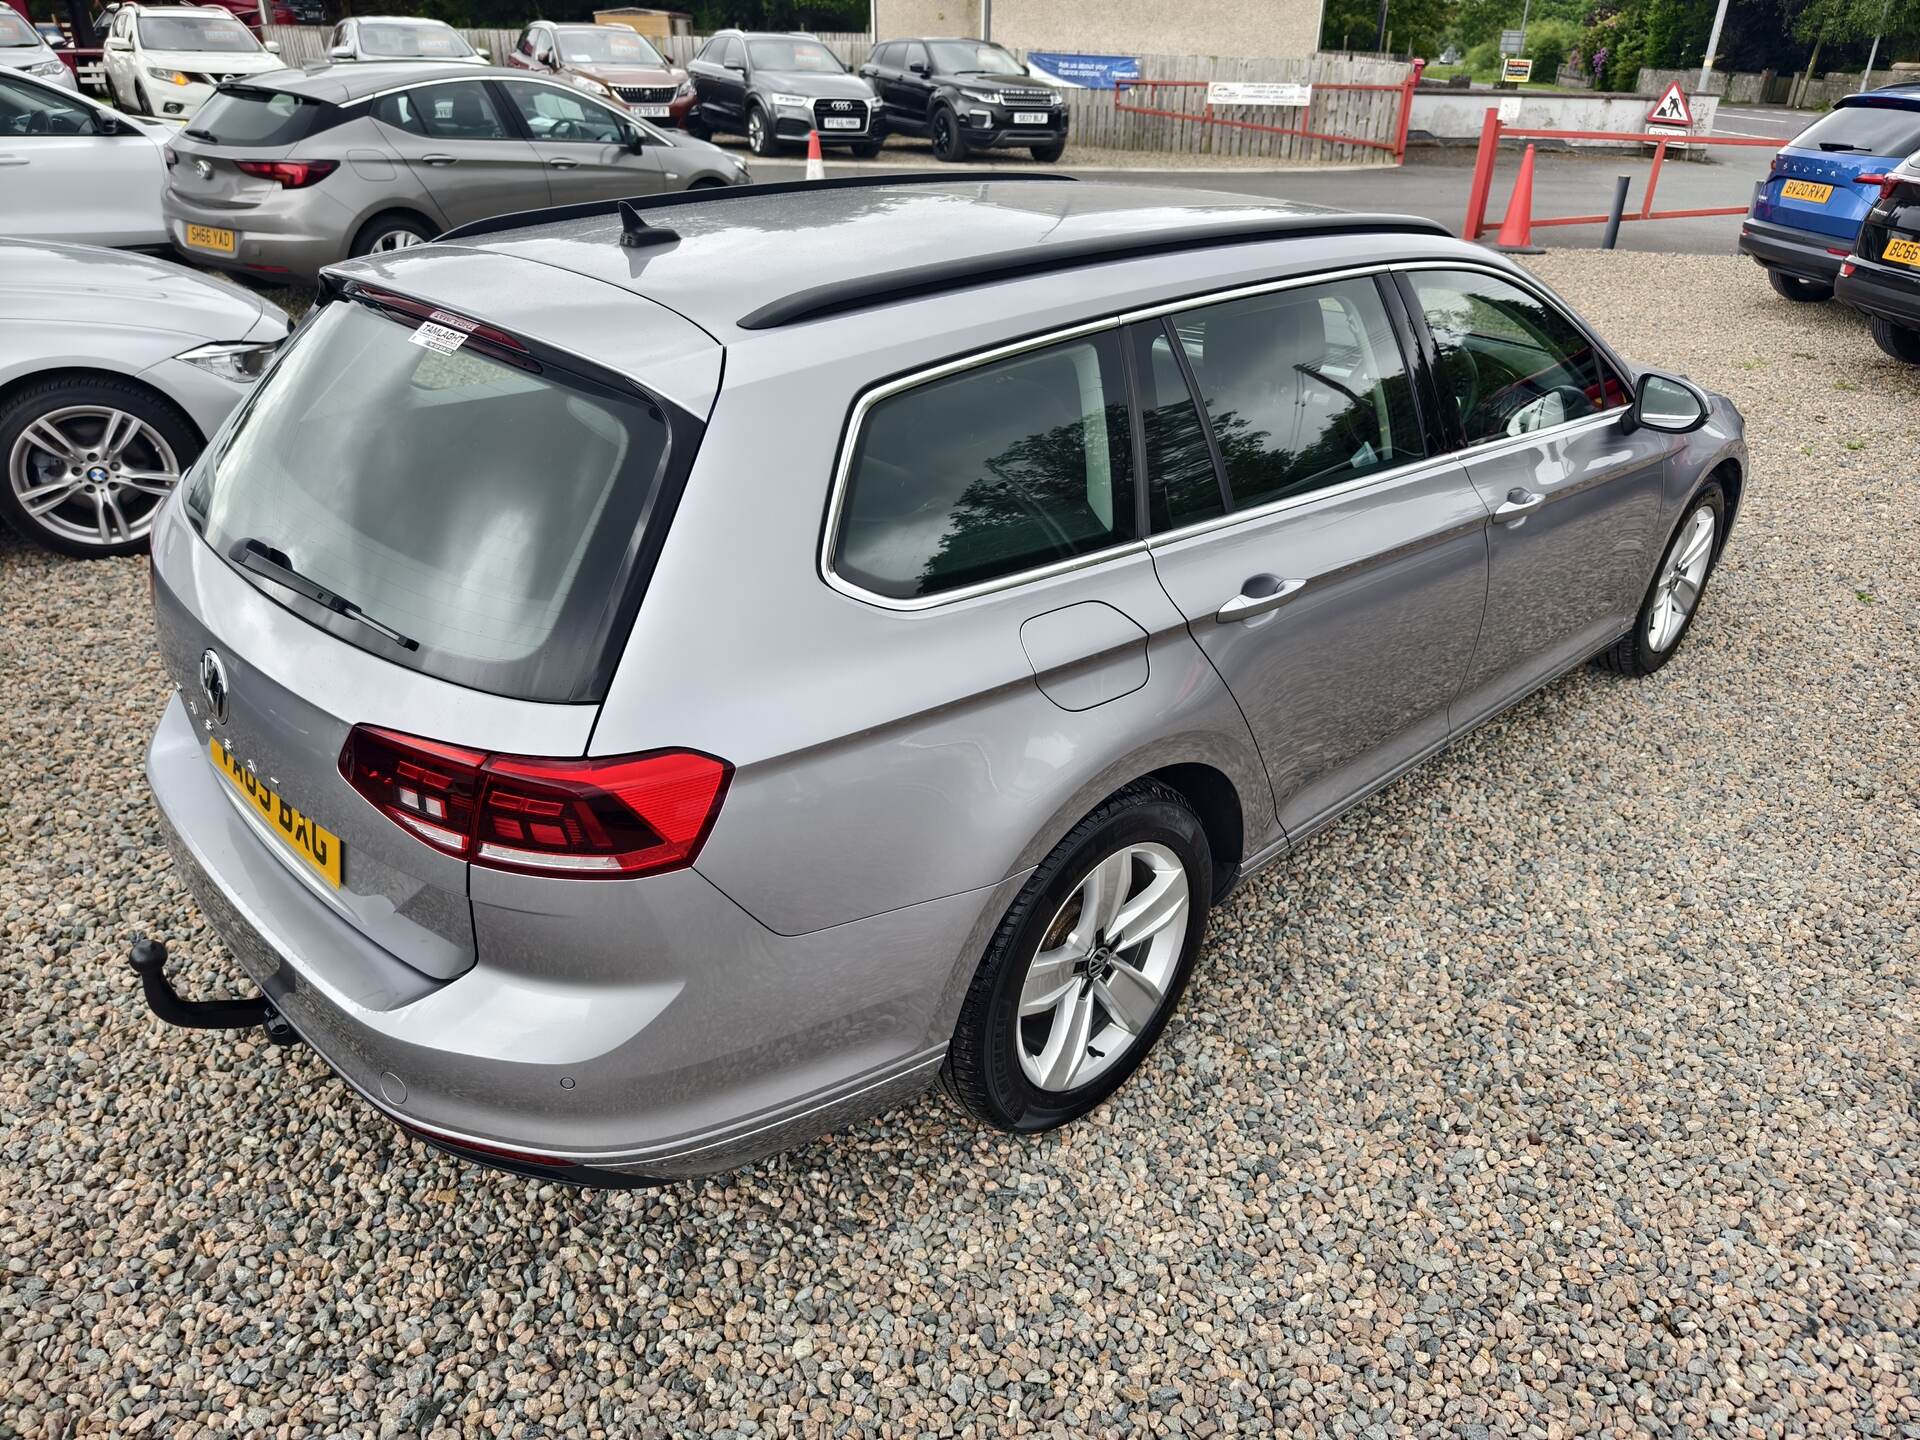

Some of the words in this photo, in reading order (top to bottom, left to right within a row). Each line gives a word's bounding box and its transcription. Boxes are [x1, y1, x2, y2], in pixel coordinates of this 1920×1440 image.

[1078, 62, 1094, 70] about
[1095, 64, 1108, 72] your
[1786, 180, 1810, 196] BV20
[1808, 184, 1827, 200] RVA
[213, 231, 230, 247] YAD
[1889, 241, 1919, 260] BC66
[421, 324, 466, 343] TAMLAGHT
